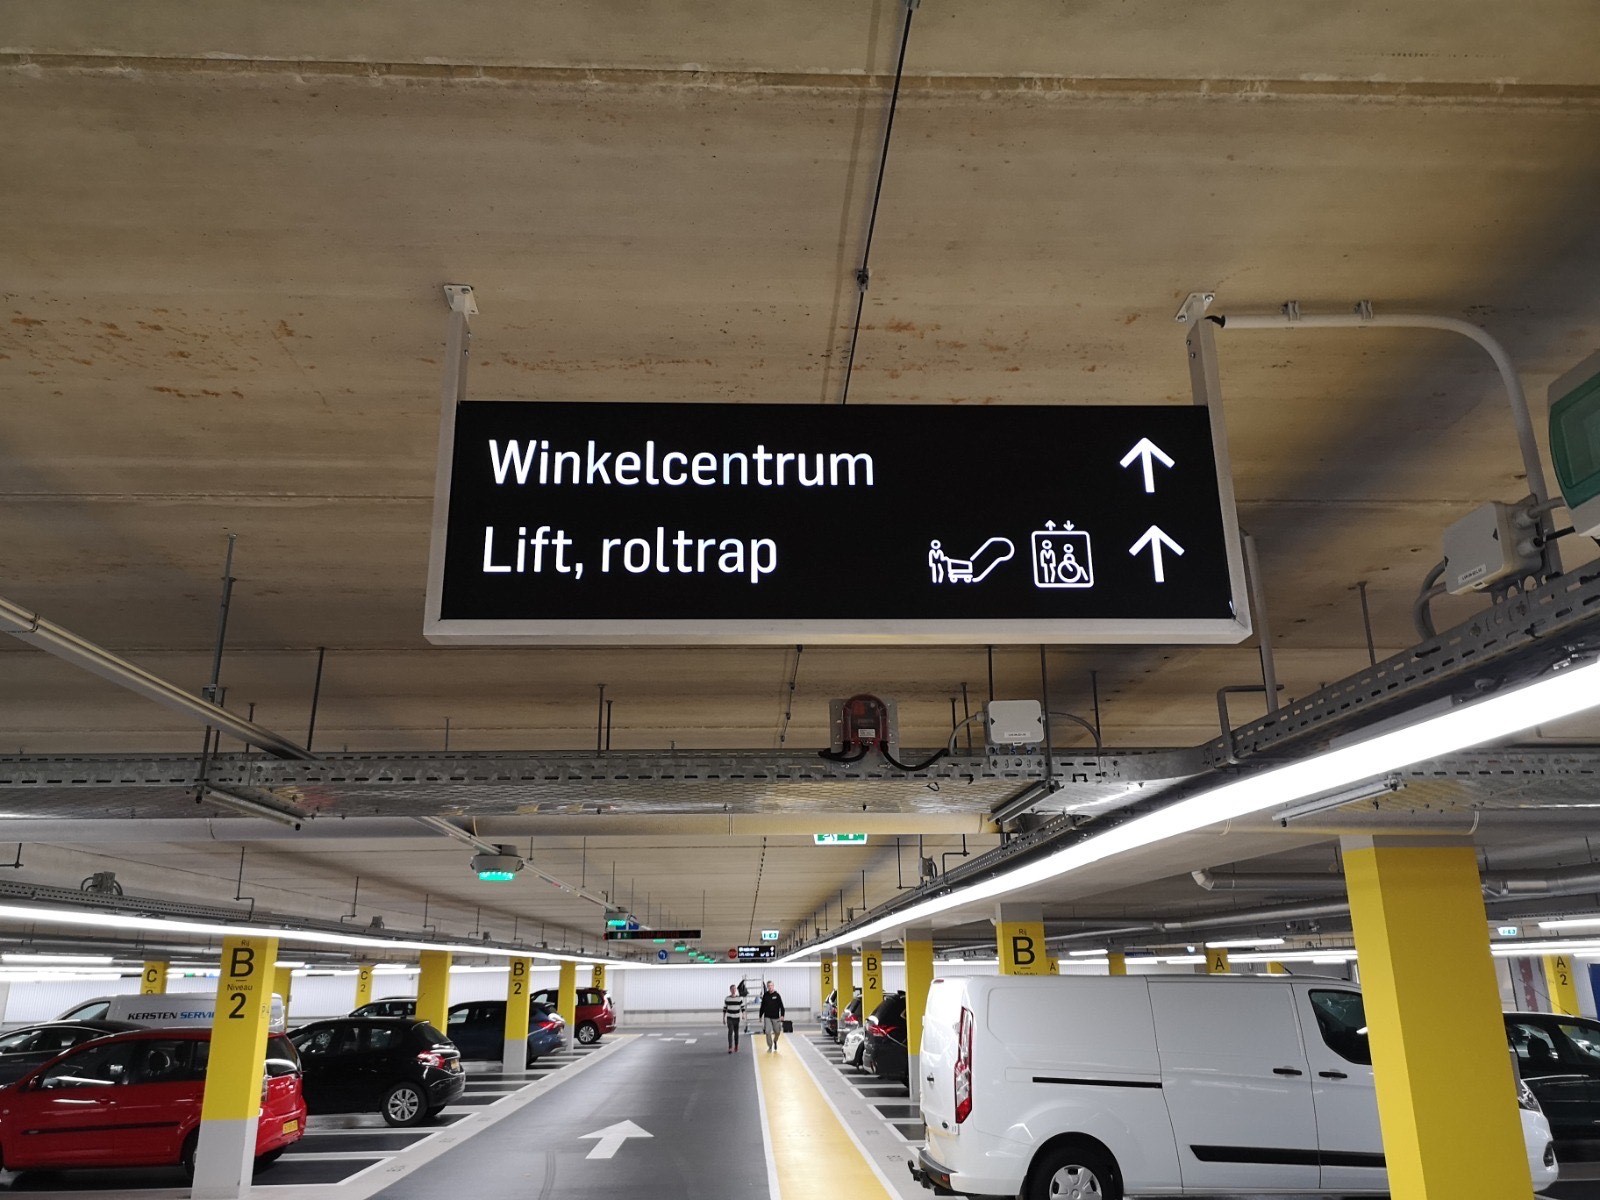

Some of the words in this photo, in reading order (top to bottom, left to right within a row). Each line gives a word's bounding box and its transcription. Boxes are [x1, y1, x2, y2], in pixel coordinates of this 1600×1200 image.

[488, 438, 875, 487] Winkelcentrum
[482, 525, 585, 580] Lift,
[600, 526, 778, 585] roltrap
[1012, 936, 1036, 966] B
[229, 947, 255, 978] B
[513, 962, 525, 976] B
[823, 963, 831, 972] B
[867, 957, 878, 971] B
[1049, 962, 1057, 971] A
[1215, 956, 1225, 970] A
[1556, 956, 1566, 969] A
[146, 969, 158, 983] C
[360, 970, 368, 980] C
[594, 966, 603, 976] B
[595, 979, 601, 988] 2
[824, 976, 831, 984] 2
[869, 977, 877, 989] 2
[1559, 973, 1568, 986] 2
[360, 983, 366, 993] 2
[513, 982, 522, 995] 2
[228, 992, 247, 1019] 2
[127, 1011, 178, 1020] KERSTEN
[180, 1011, 215, 1020] SERVI
